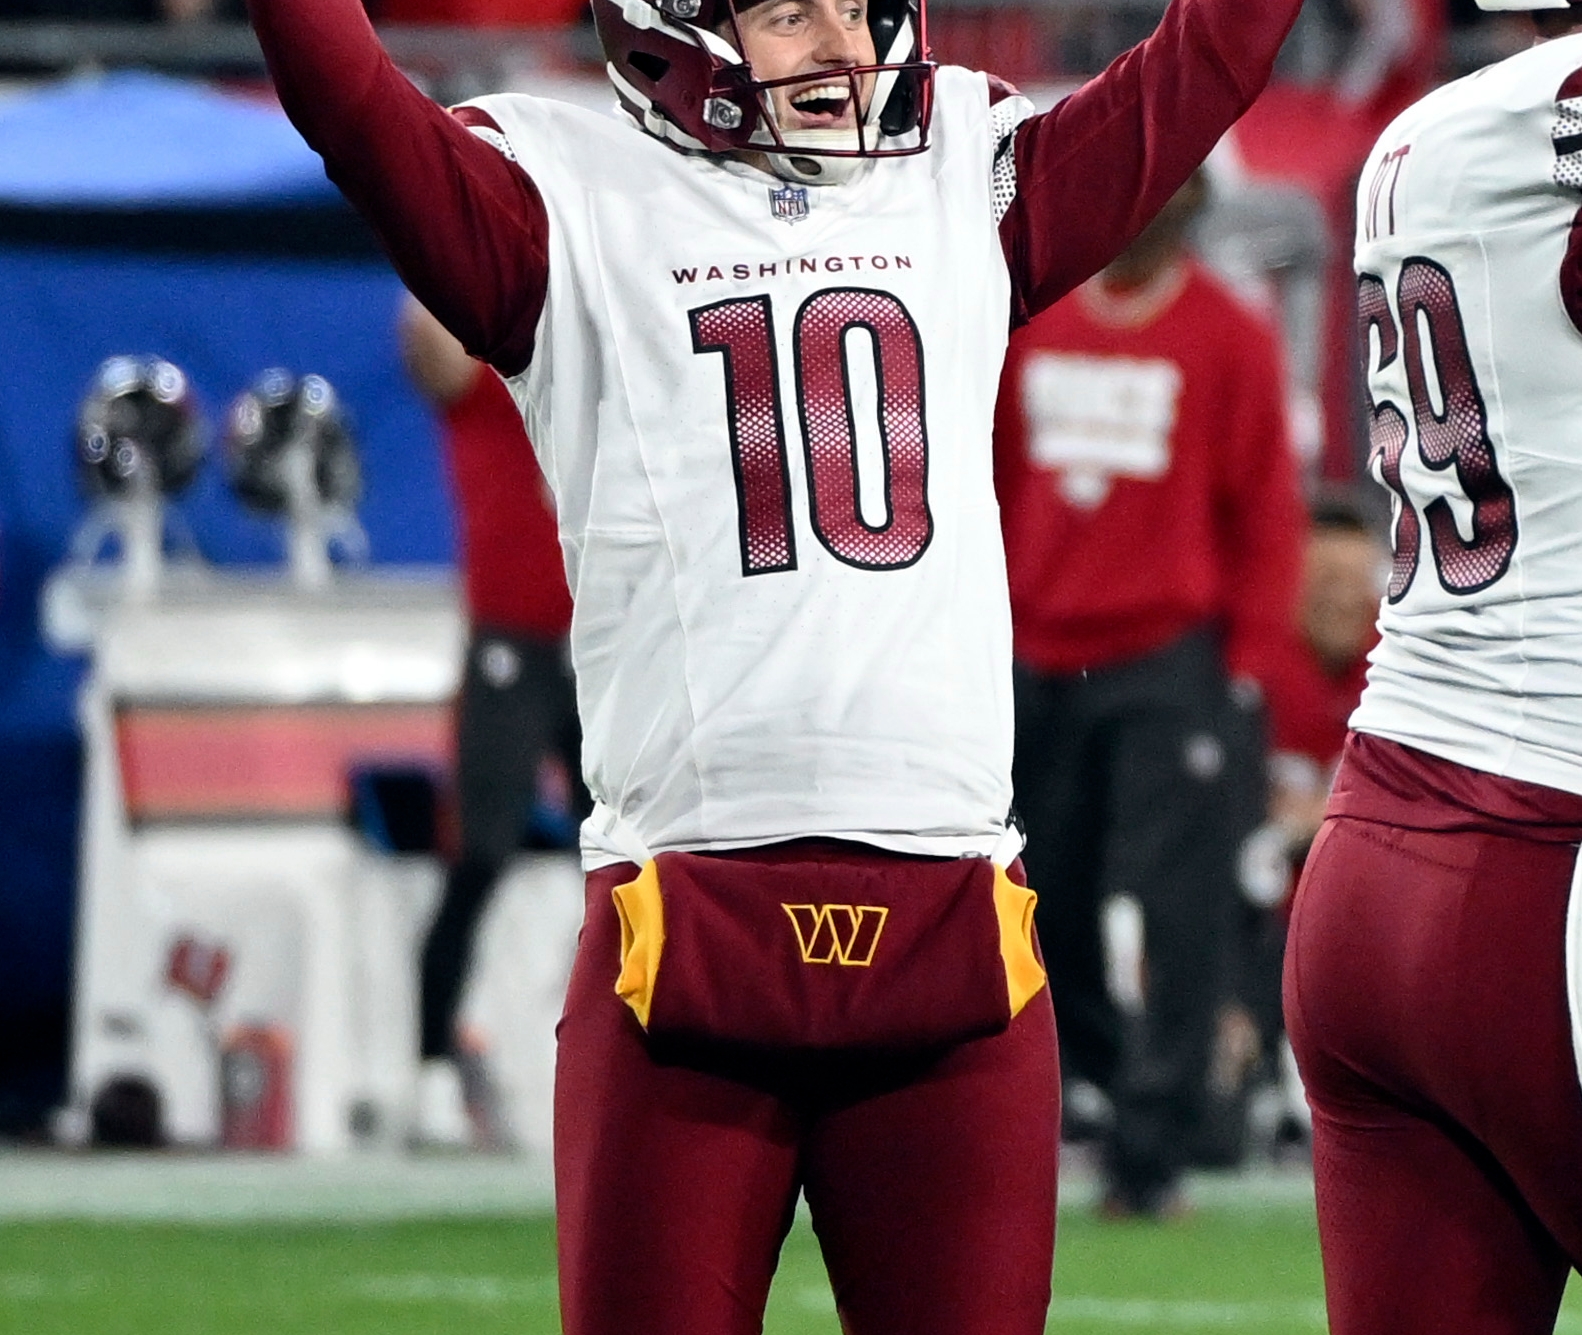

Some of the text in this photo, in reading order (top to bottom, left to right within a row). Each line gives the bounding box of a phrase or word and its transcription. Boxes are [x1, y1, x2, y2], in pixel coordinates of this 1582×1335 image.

[672, 254, 913, 285] WASHINGTON
[687, 285, 935, 578] 10
[1357, 255, 1519, 605] 69
